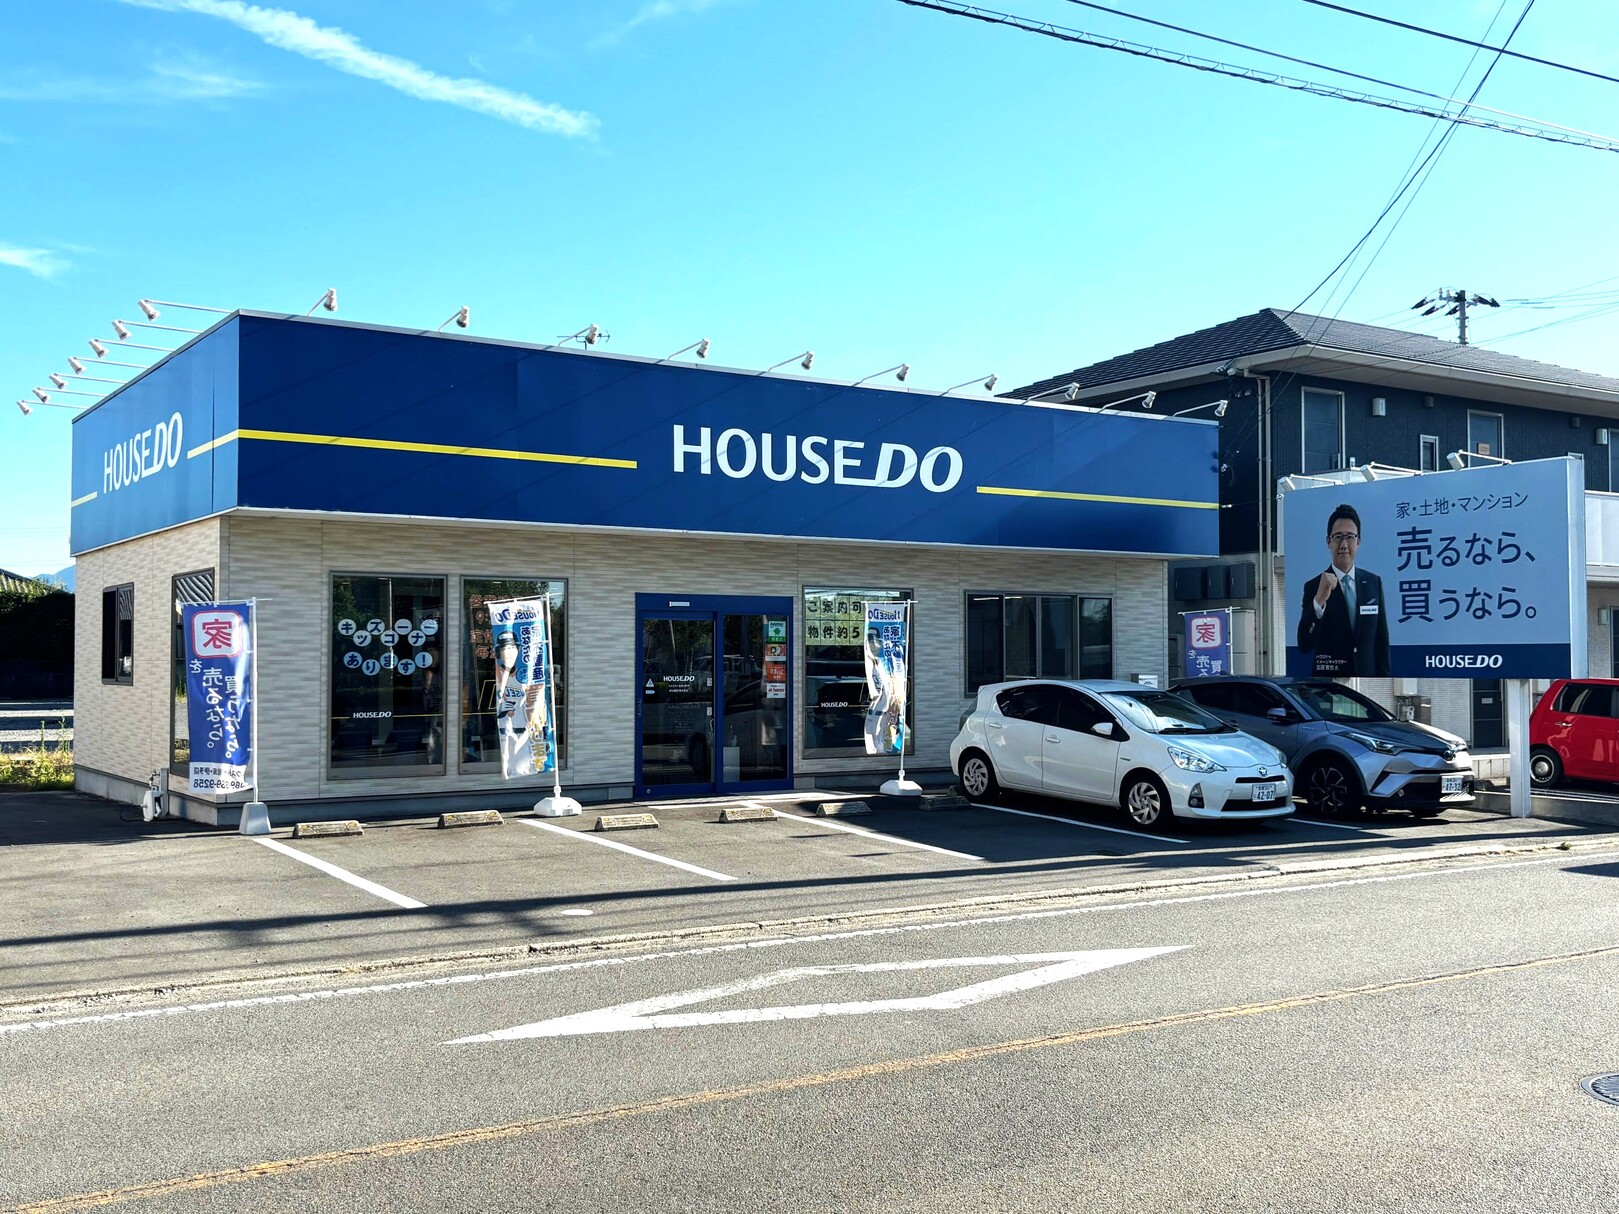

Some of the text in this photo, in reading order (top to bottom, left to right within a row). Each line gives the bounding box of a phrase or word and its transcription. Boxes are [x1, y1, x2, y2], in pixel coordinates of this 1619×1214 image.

[1395, 491, 1529, 519] 家・土地・マンション
[1396, 526, 1537, 572] 売るなら、
[807, 600, 862, 614] ご案内可
[1397, 579, 1537, 624] 買うなら。
